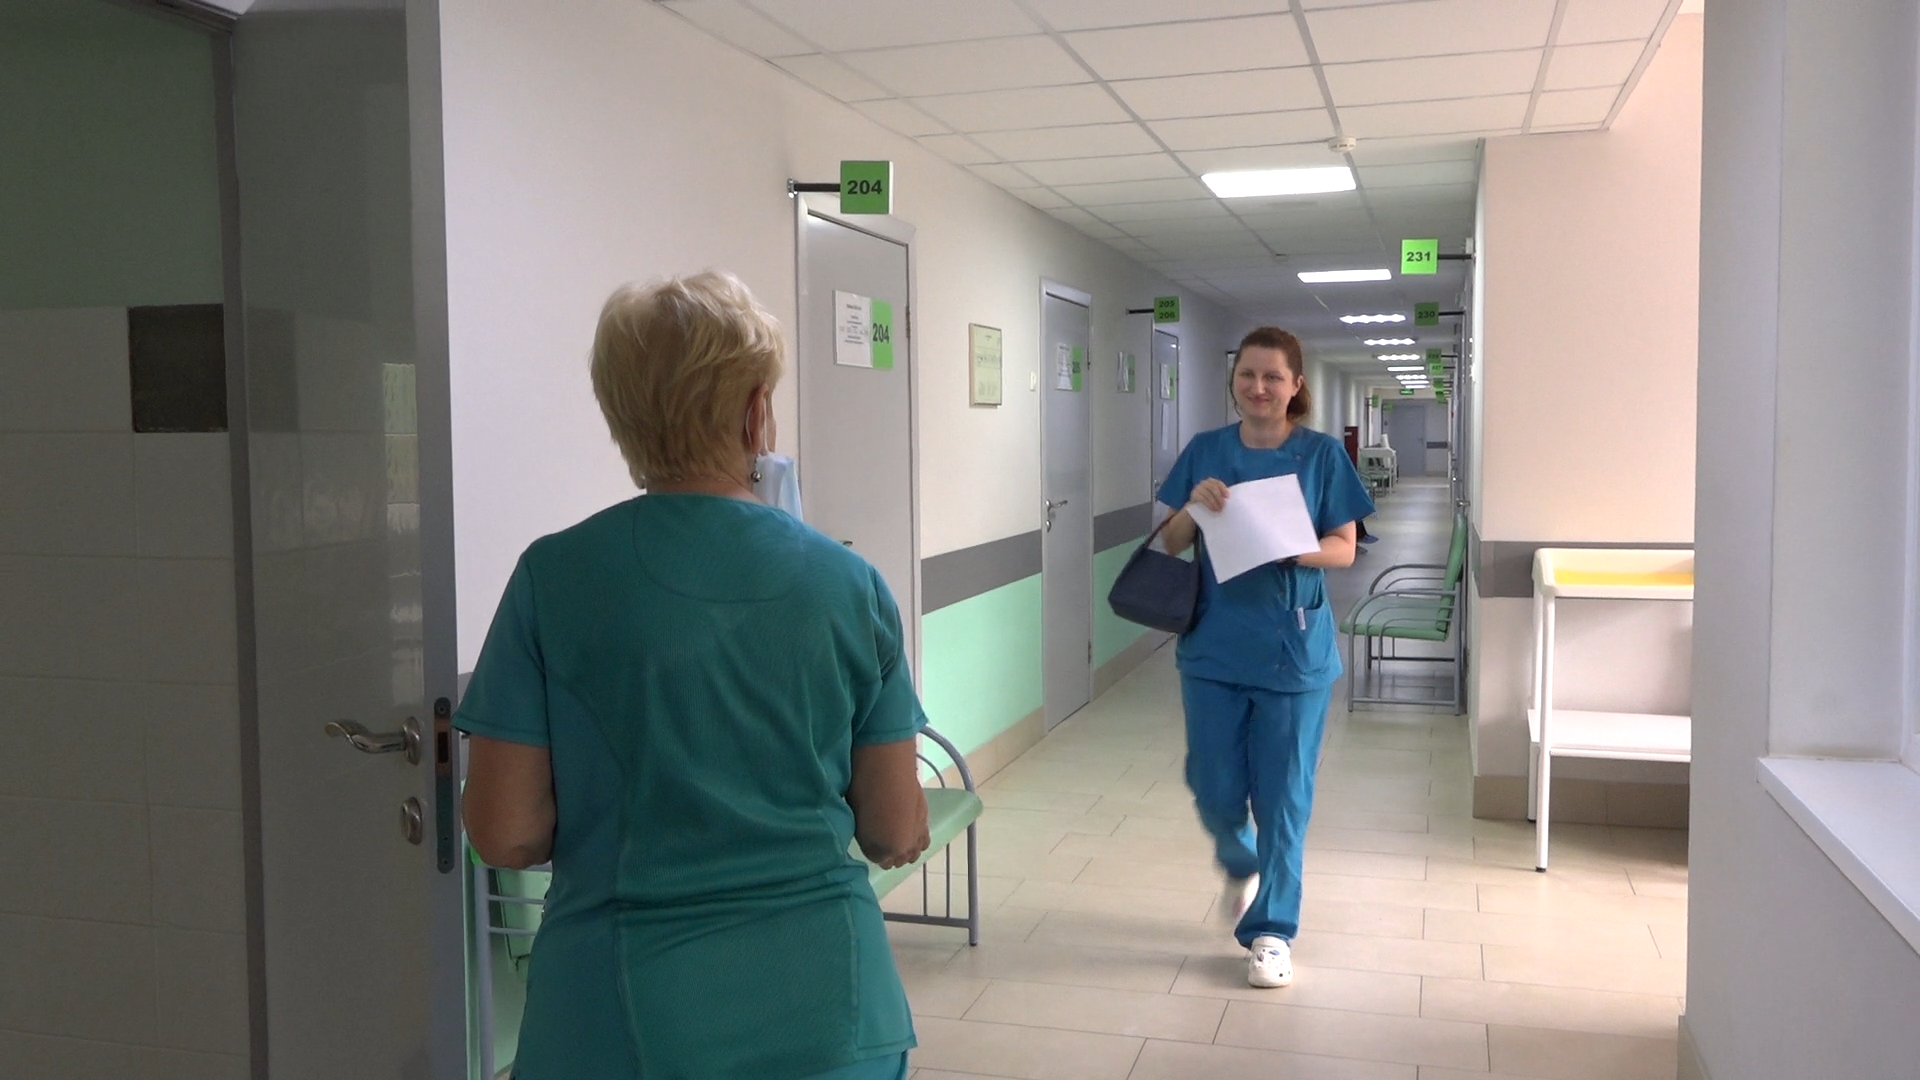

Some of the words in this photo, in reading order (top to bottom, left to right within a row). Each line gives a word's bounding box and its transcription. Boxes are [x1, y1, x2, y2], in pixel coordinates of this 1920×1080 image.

[847, 179, 883, 195] 204
[1406, 251, 1432, 262] 231
[1417, 310, 1436, 319] 230
[872, 322, 890, 344] 204
